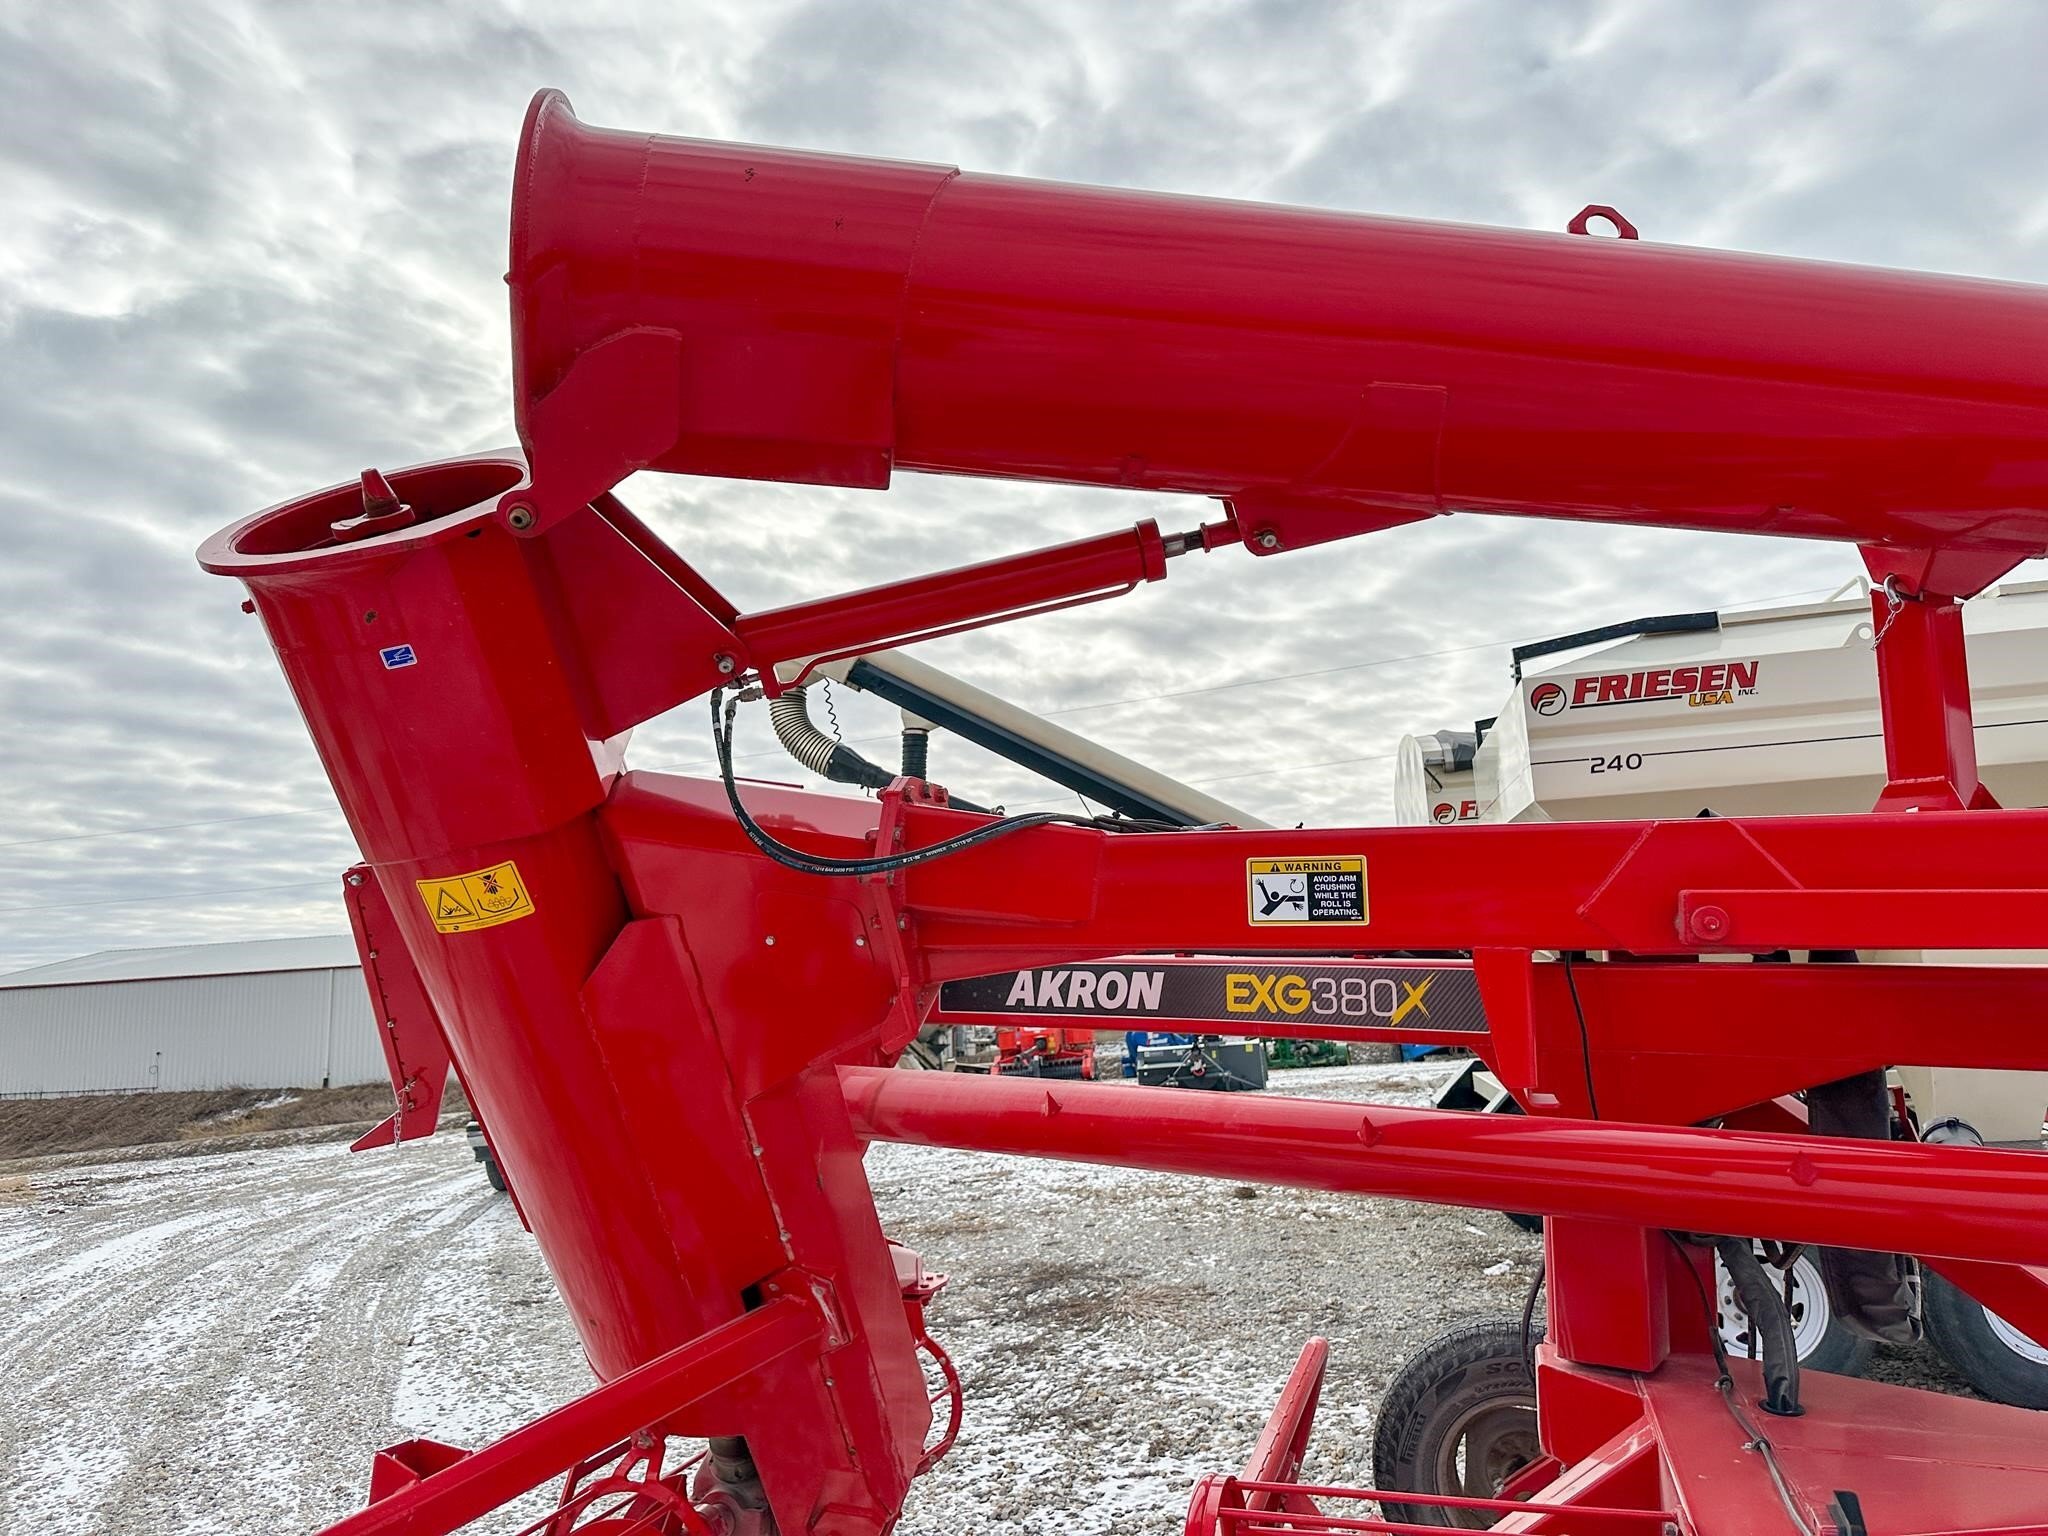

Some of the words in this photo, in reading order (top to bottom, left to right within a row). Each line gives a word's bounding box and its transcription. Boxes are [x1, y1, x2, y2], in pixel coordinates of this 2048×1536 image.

[1571, 661, 1759, 705] FRIESEN
[1688, 690, 1734, 708] USA
[1738, 688, 1759, 696] INC.
[1590, 753, 1643, 774] 240
[1284, 862, 1342, 872] WARNING
[1314, 883, 1356, 891] CRUSHING
[1341, 891, 1357, 899] THE
[1320, 900, 1342, 908] ROLL
[1343, 900, 1351, 908] IS
[1312, 908, 1361, 916] OPERATING.
[1005, 970, 1165, 1010] AKRON
[1226, 971, 1439, 1027] EXG380X
[1400, 1411, 1427, 1465] PIRELLI
